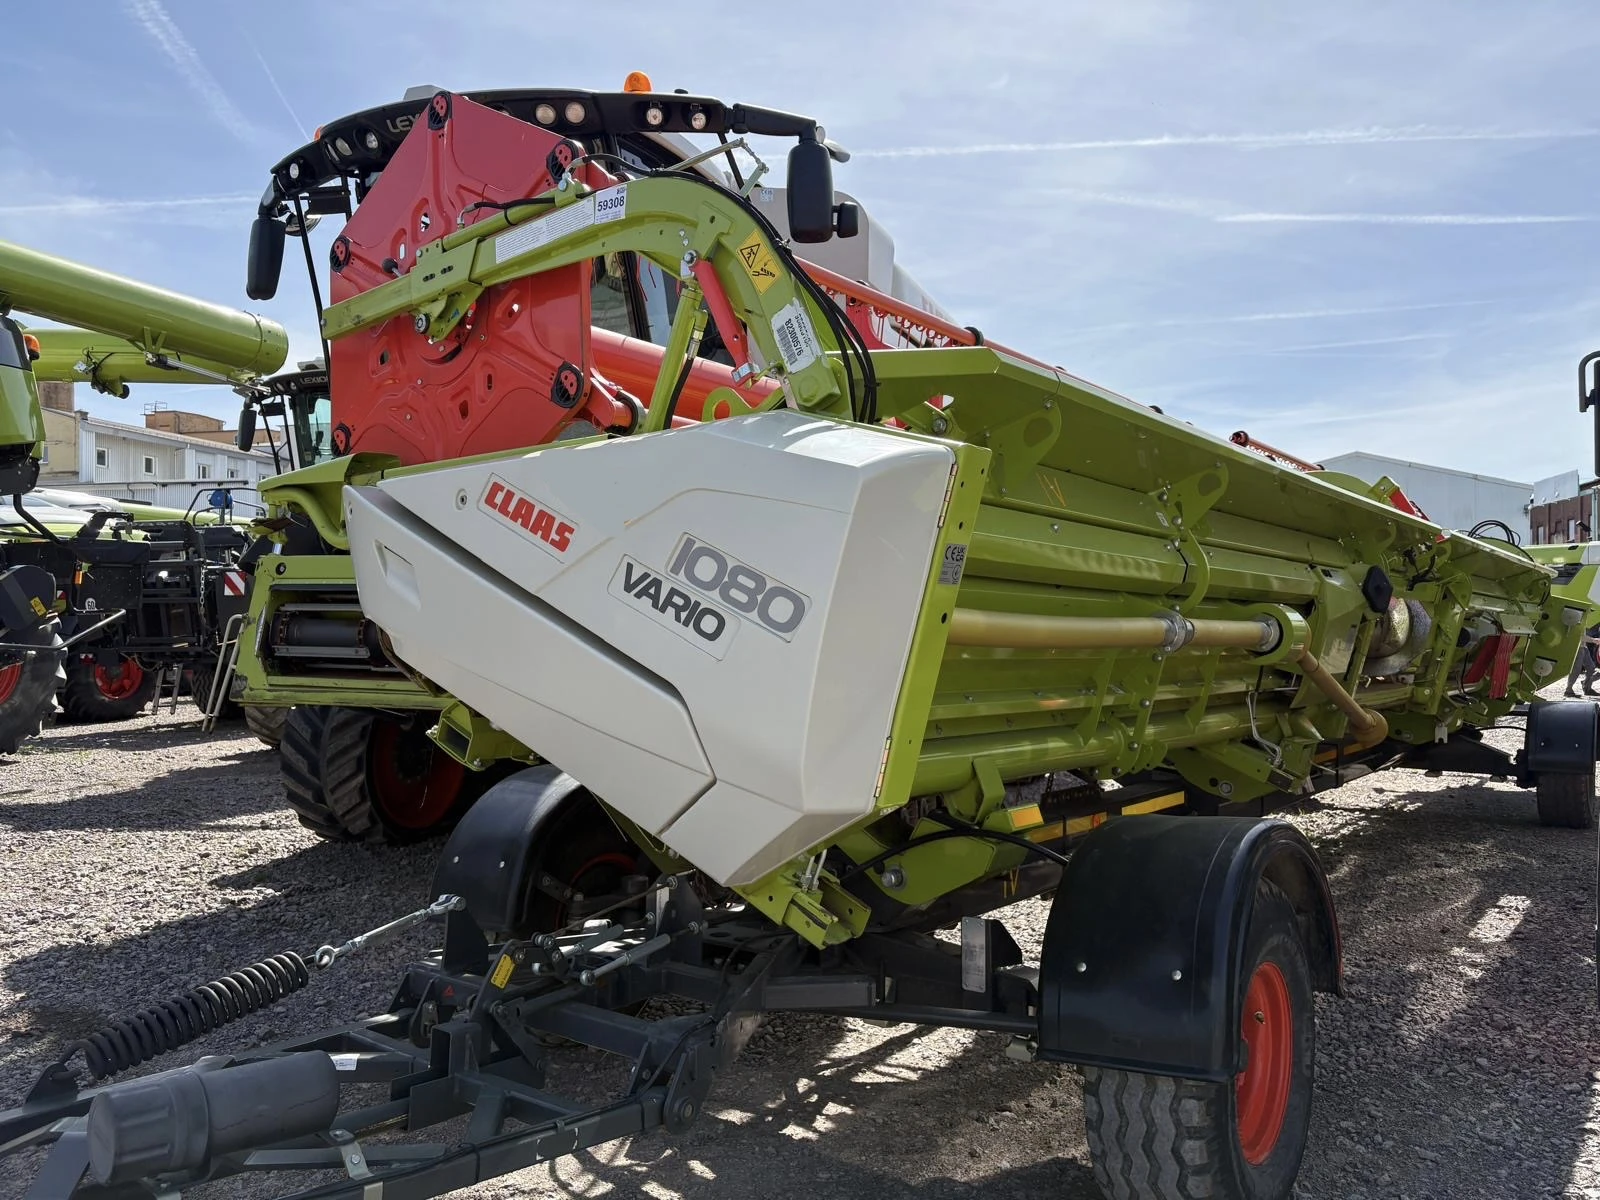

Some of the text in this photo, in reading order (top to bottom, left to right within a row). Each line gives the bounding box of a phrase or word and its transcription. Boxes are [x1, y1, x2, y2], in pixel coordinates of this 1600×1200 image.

[597, 196, 625, 212] 59308
[484, 481, 575, 552] CLAAS
[622, 561, 726, 641] VARIO
[669, 537, 806, 634] 1080
